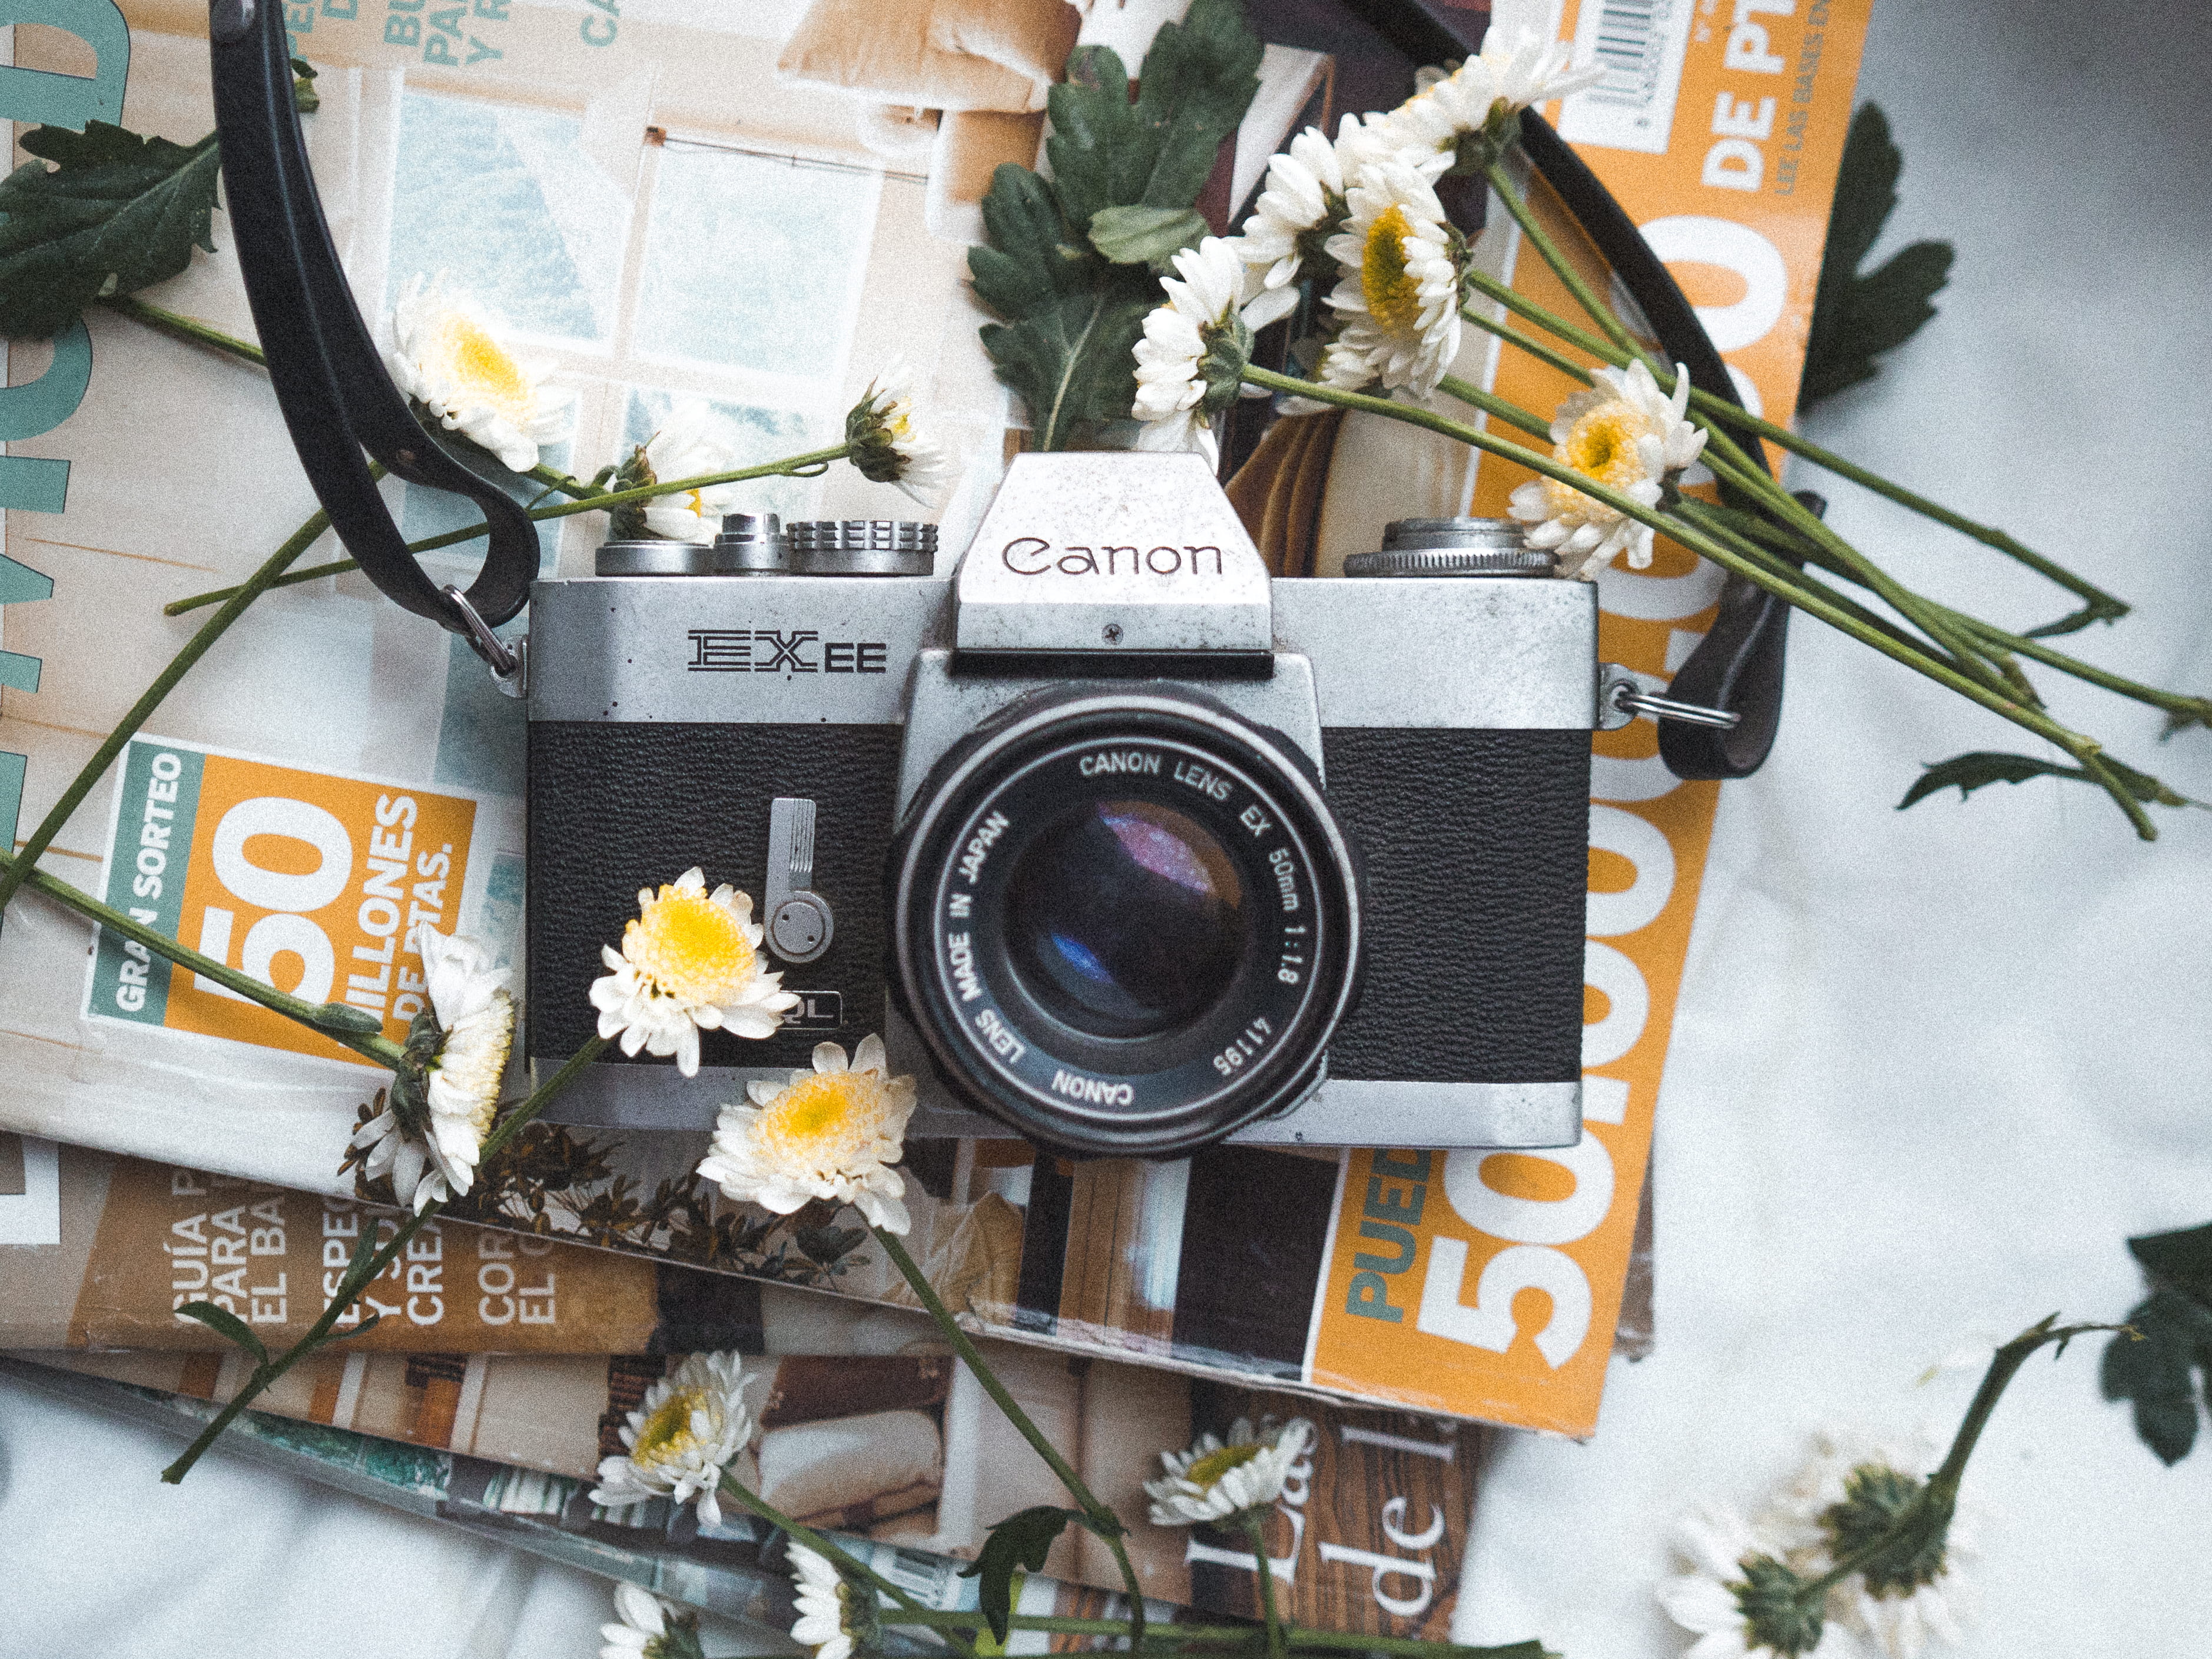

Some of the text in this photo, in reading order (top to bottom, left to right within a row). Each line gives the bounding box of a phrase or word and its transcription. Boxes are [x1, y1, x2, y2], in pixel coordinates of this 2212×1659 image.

[1700, 91, 1777, 192] DE
[1783, 110, 1809, 152] LAS
[1001, 536, 1223, 576] Canon
[1080, 751, 1161, 778] CANON
[1173, 760, 1232, 802] LENS
[1239, 804, 1272, 838] EX
[1268, 848, 1298, 911] 50mm
[116, 752, 182, 1012] GRAN SORTEO
[194, 796, 353, 1011] 50
[337, 794, 417, 1048] ILLONES
[392, 966, 428, 1022] DE
[947, 810, 1134, 1106] CANON LENS MADE IN JAPAN
[251, 1272, 287, 1323] EL
[366, 1296, 402, 1318] Y
[518, 1273, 555, 1324] EL
[1318, 1496, 1445, 1617] de
